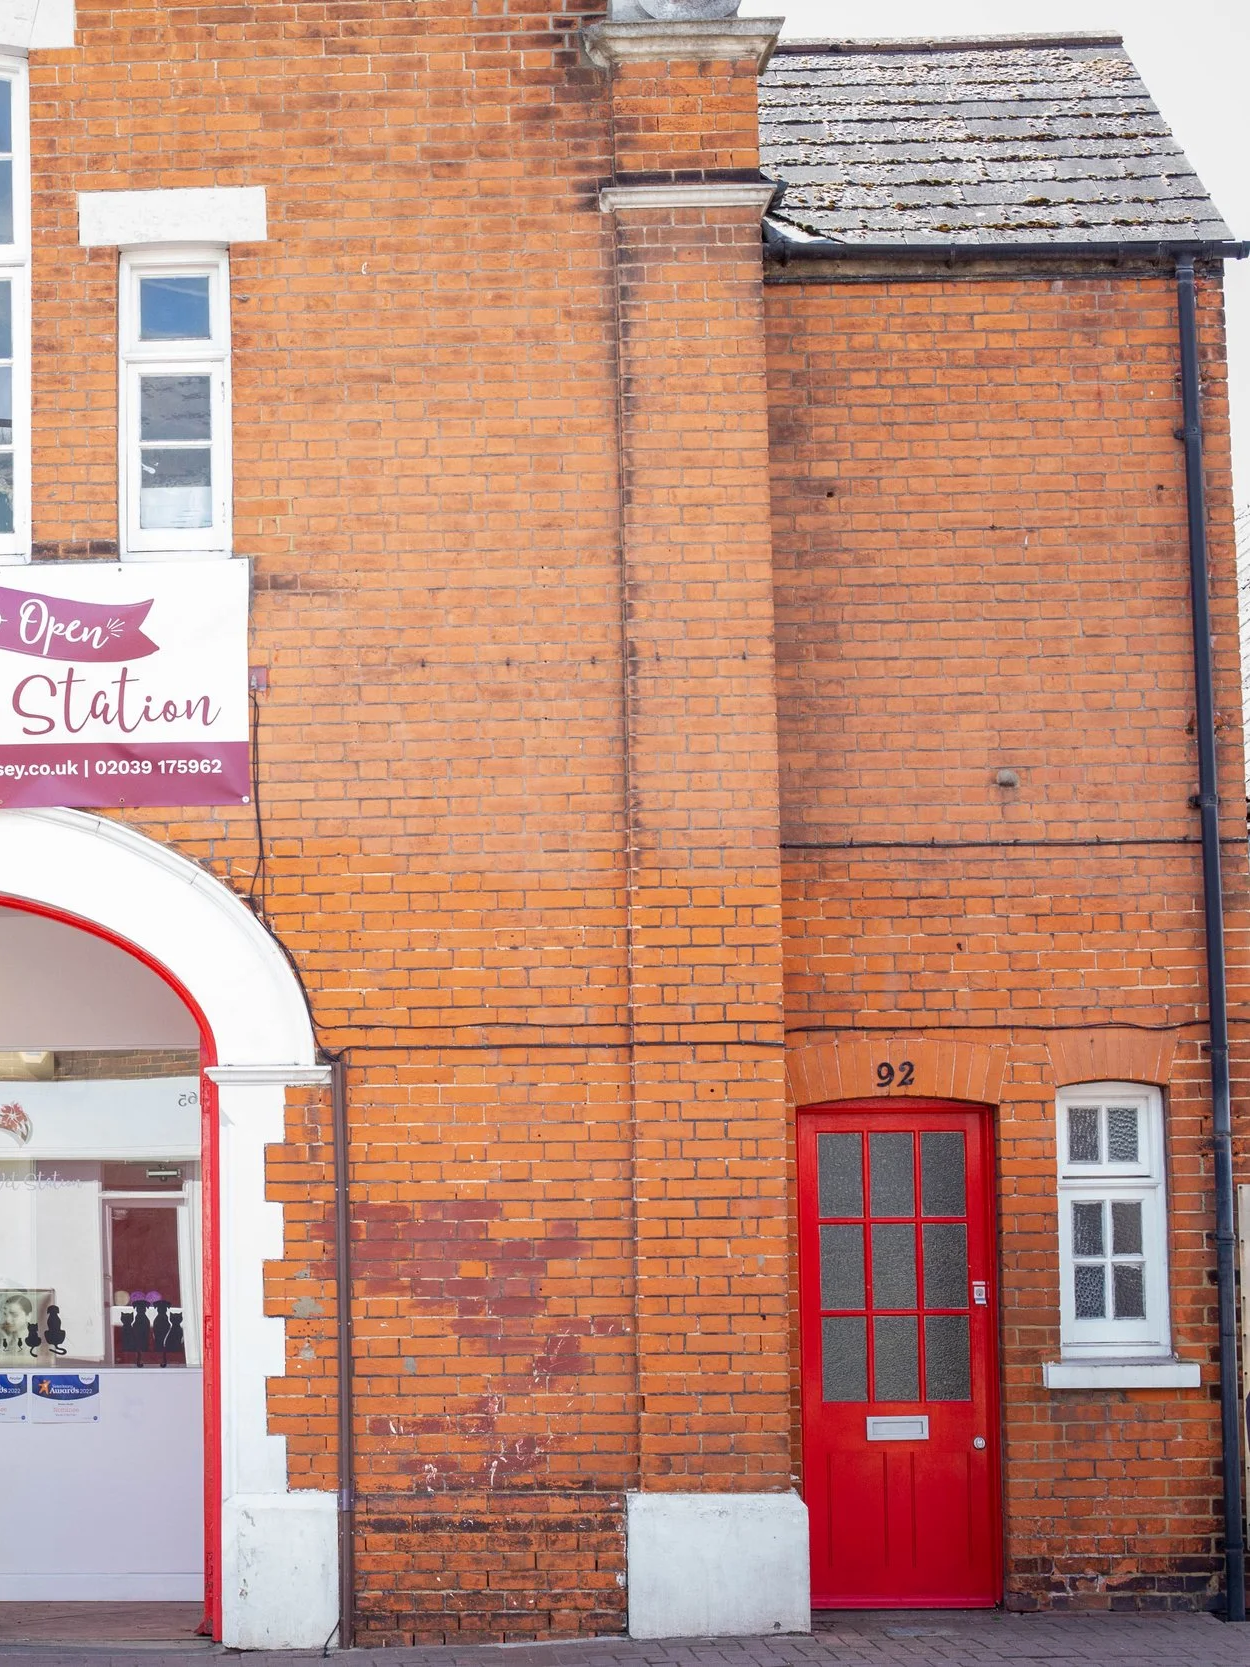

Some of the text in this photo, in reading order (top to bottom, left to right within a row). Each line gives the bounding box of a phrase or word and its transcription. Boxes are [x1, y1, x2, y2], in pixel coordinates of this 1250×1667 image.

[19, 598, 110, 656] Open
[12, 667, 221, 736] Station
[95, 760, 153, 775] 02039
[158, 759, 223, 774] 175962
[876, 1061, 915, 1088] 92
[49, 1387, 80, 1395] Awards
